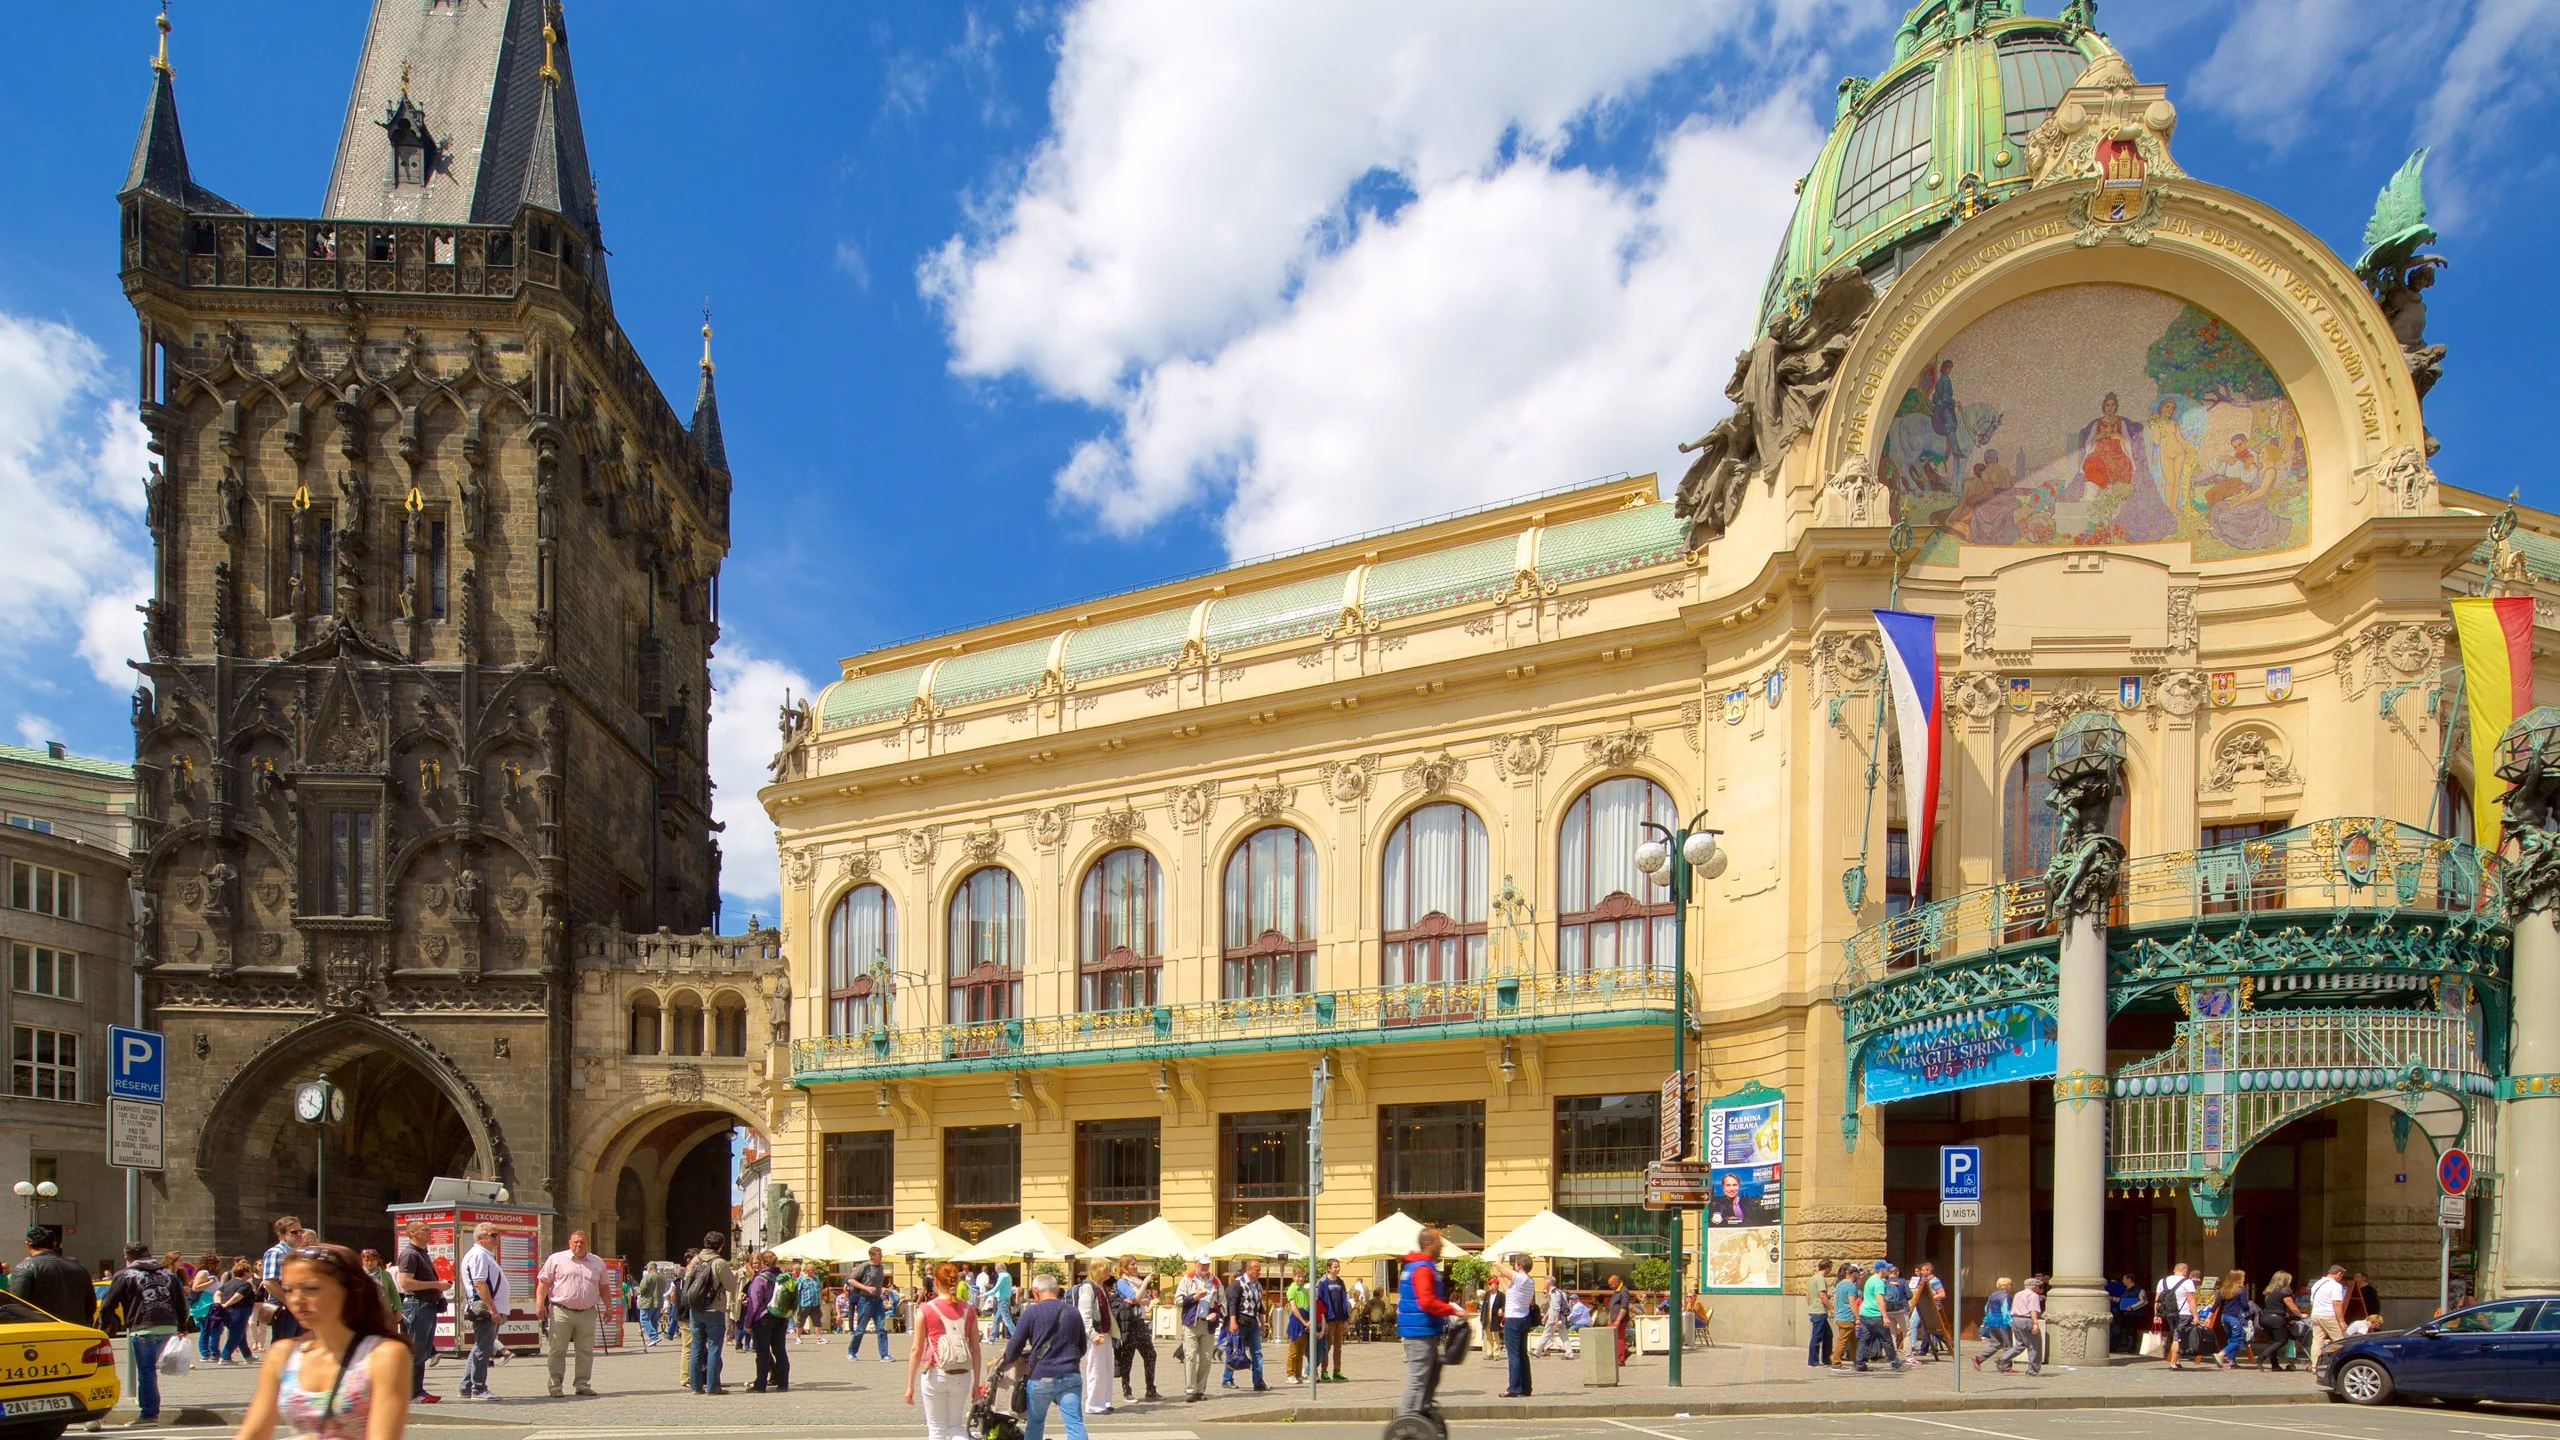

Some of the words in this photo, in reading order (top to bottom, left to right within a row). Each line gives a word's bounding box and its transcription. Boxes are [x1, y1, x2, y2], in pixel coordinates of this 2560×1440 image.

[2158, 216, 2193, 237] JAK
[1914, 256, 1980, 311] VZDORUJ
[1971, 1022, 2009, 1042] JARO
[123, 1036, 153, 1076] P
[1900, 1047, 1958, 1070] PRAGUE
[1960, 1036, 2015, 1059] SPRING
[1729, 1114, 1761, 1124] CARMINA
[1729, 1121, 1759, 1131] BURANA
[1711, 1115, 1723, 1163] PROMS
[1950, 1153, 1972, 1184] P
[1945, 1186, 1977, 1194] RÉSERVÉ
[475, 1213, 523, 1223] EXCURSIONS
[1945, 1209, 1950, 1218] 3
[1952, 1207, 1977, 1218] MÍSTA
[6, 1402, 30, 1414] 2AV
[38, 1398, 68, 1411] 7183
